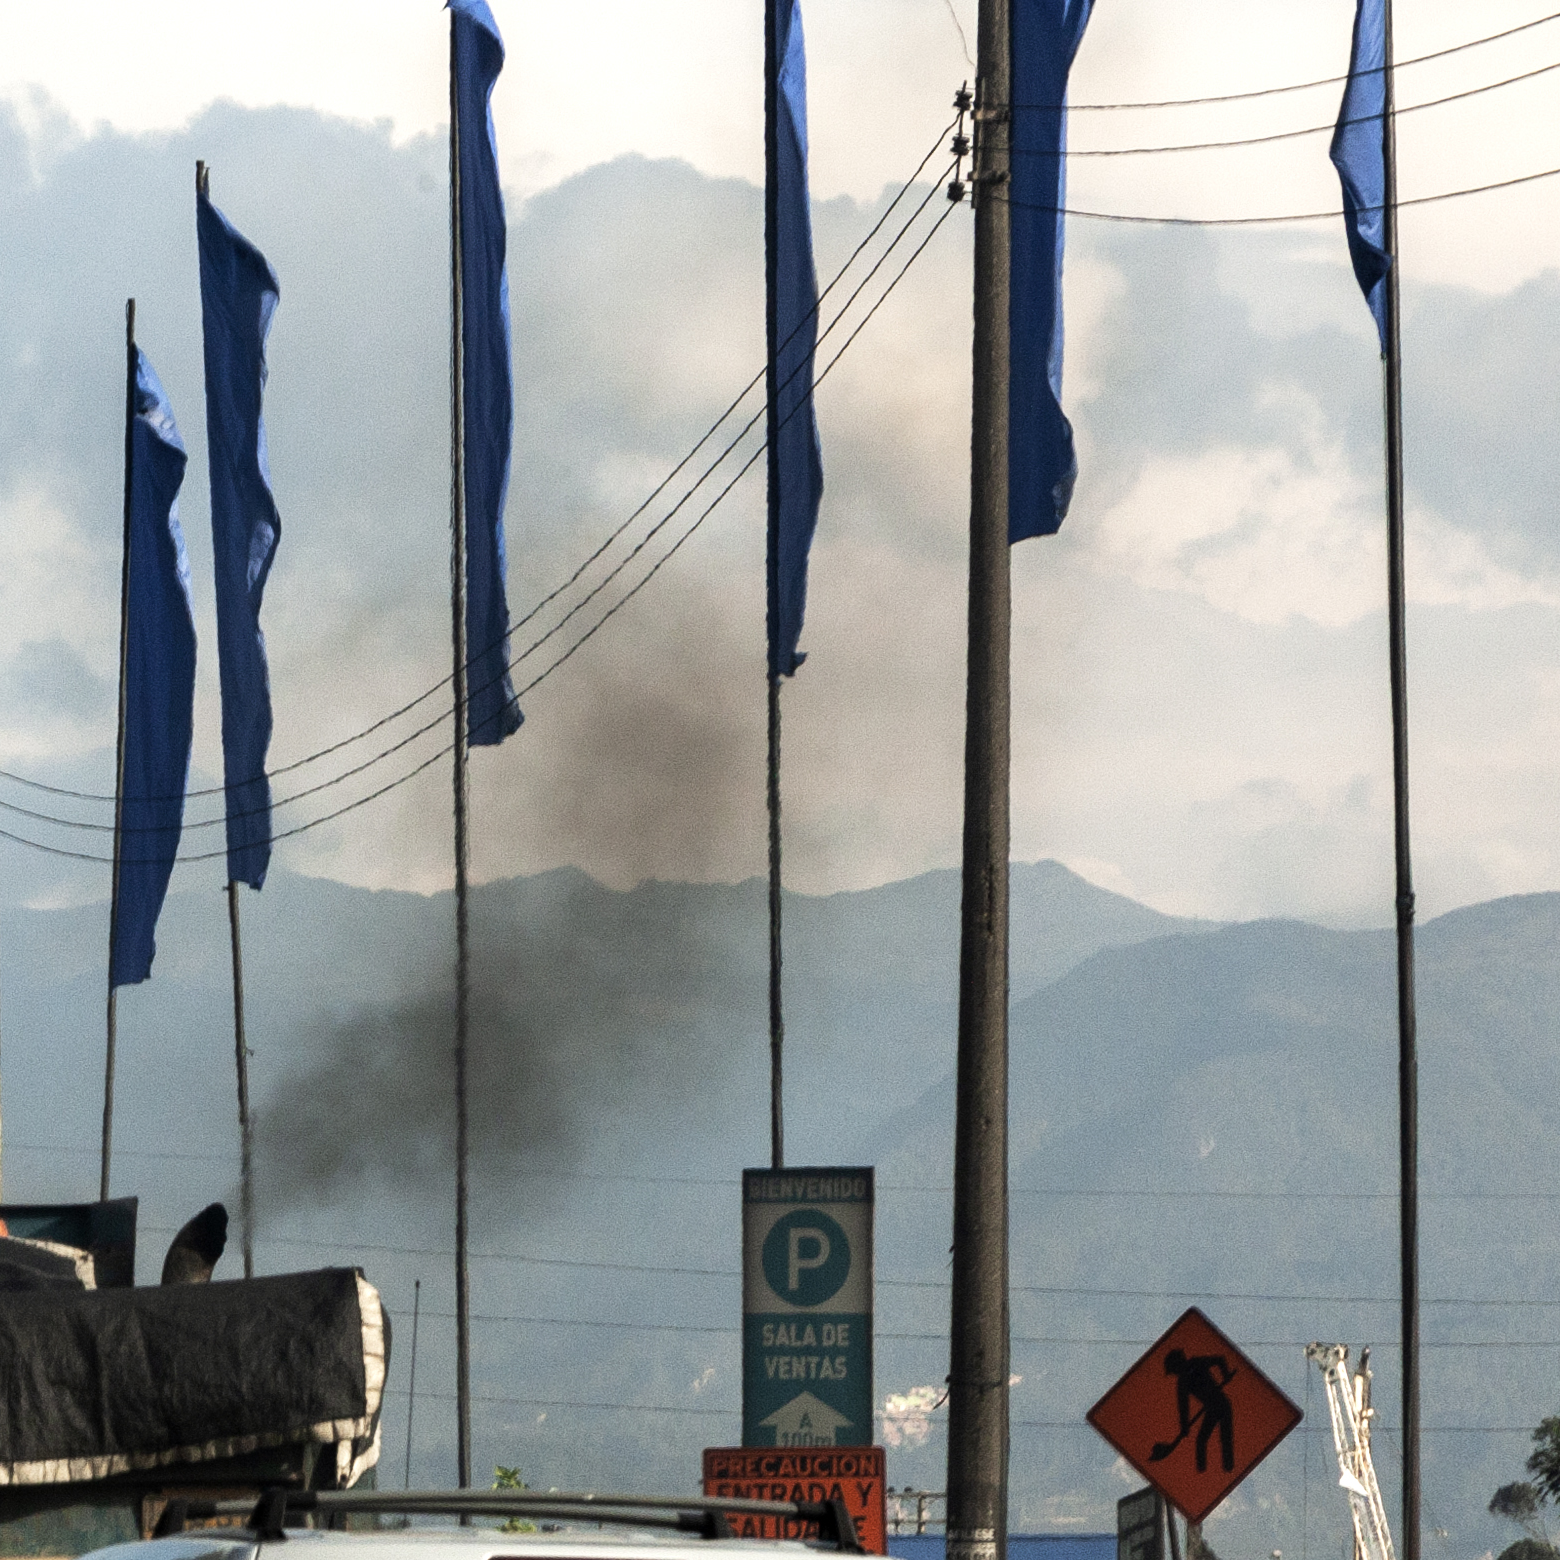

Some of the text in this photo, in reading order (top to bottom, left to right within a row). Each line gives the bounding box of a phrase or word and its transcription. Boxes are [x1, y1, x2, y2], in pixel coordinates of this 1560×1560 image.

[748, 1177, 867, 1200] BIENVENIDO
[787, 1227, 831, 1291] P
[761, 1322, 850, 1348] SALA DE
[764, 1355, 847, 1381] VENTAS
[799, 1411, 813, 1430] A
[855, 1481, 874, 1508] Y
